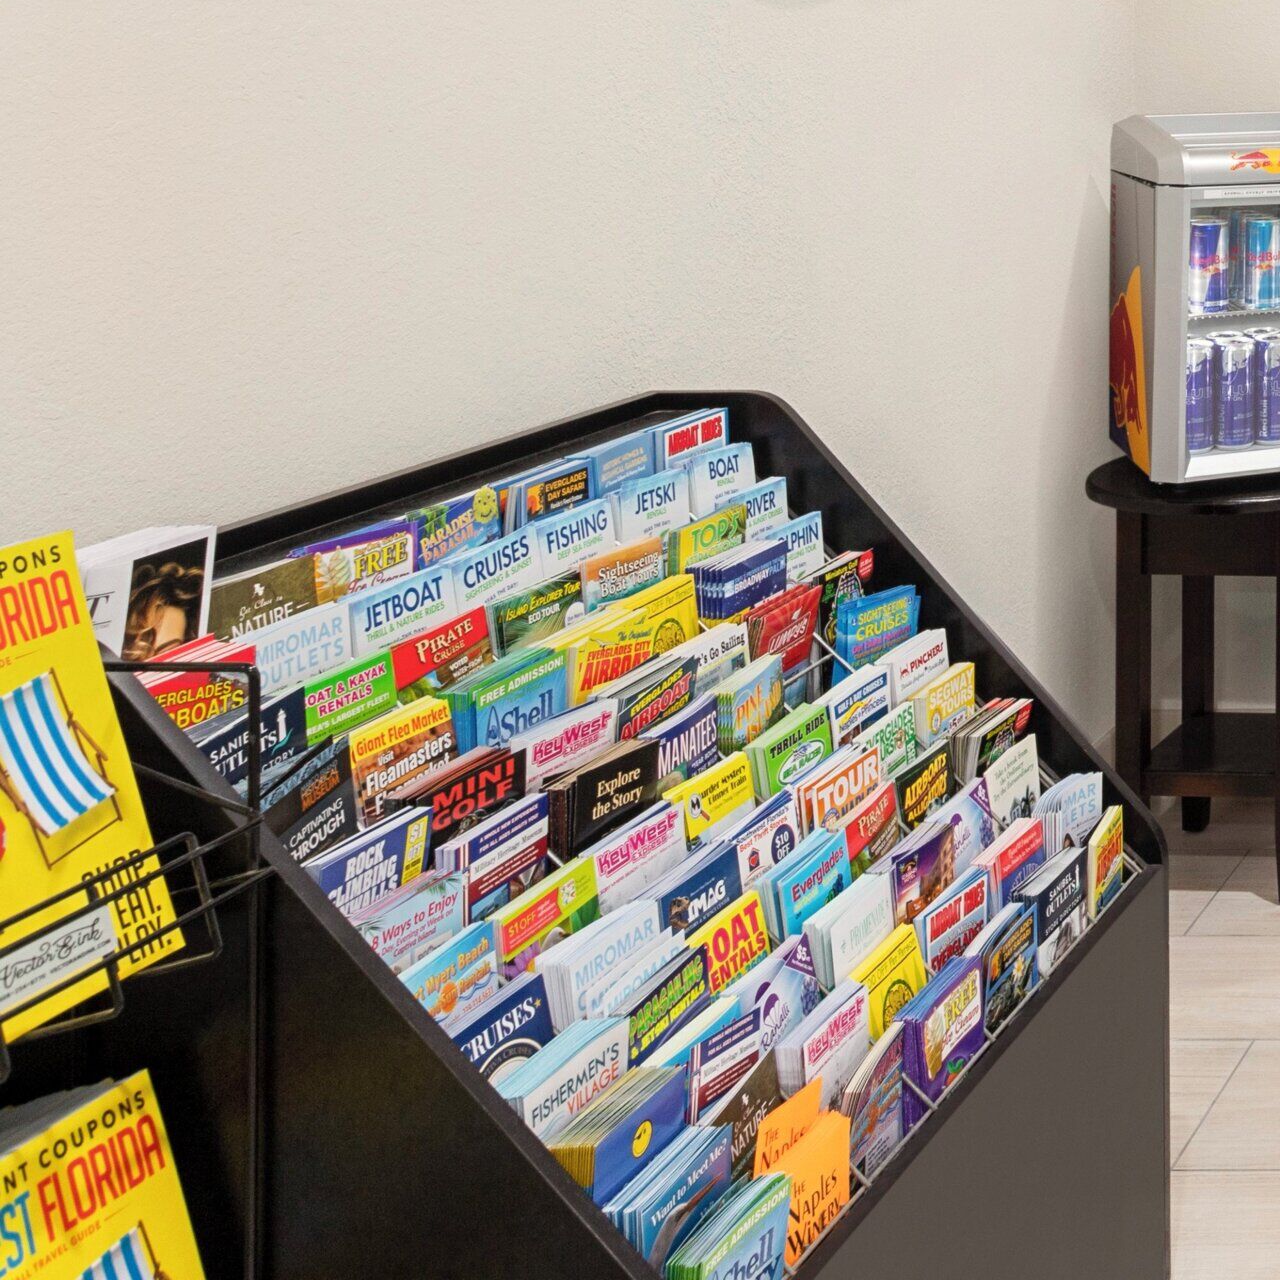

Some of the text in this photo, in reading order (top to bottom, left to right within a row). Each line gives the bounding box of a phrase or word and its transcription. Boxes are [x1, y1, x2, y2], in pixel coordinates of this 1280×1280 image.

[545, 471, 587, 493] EVERGLADES
[709, 454, 739, 480] BOAT
[547, 481, 585, 501] DAY SAFARI
[635, 481, 676, 515] JETSKI
[421, 509, 473, 549] PARADISE
[546, 510, 607, 554] FISHING
[354, 537, 408, 579] FREE
[464, 535, 530, 589] CRUISES
[599, 552, 659, 583] Sightseeing
[506, 582, 581, 621] ISLAND EXPLORER TOUR
[600, 567, 658, 598] Boat Tours
[365, 576, 442, 633] JETBOAT
[425, 602, 445, 617] RIDES
[529, 603, 560, 625] ECO TOUR
[257, 617, 343, 665] MIROMAR
[415, 619, 473, 658] PIRATE
[856, 611, 908, 641] CRUISES
[260, 638, 345, 689] OUTLETS
[434, 639, 465, 664] CRUISE
[587, 641, 650, 661] EVERGLADES CITY
[710, 633, 745, 660] Go Sailing
[910, 642, 944, 673] PINCHERS
[349, 663, 386, 689] KAYAK
[479, 656, 564, 707] FREE ADMISSION!
[929, 670, 973, 706] SEGWAY
[319, 685, 372, 717] RENTALS
[502, 688, 554, 741] Shell
[942, 685, 972, 713] TOURS
[356, 705, 448, 756] Giant Flea Market
[658, 710, 717, 779] MANATEES
[769, 714, 824, 758] THRILL RIDE
[366, 733, 452, 796] Fleamasters
[378, 751, 394, 766] Visit
[905, 752, 947, 805] AIRBOATS
[432, 758, 515, 813] MINI
[597, 768, 640, 798] Explore
[819, 753, 878, 810] TOUR
[289, 798, 343, 847] CAPTIVATING
[592, 784, 643, 821] the Story
[410, 821, 423, 842] $1
[776, 832, 789, 848] $10
[346, 840, 385, 882] ROCK
[777, 845, 790, 859] OFF
[792, 846, 843, 900] Everglades
[1049, 872, 1073, 901] SANIBEL
[688, 879, 727, 923] IMAG
[1046, 880, 1076, 918] OUTLETS
[78, 918, 103, 946] ink
[371, 893, 458, 952] 8 Ways to Enjoy
[520, 912, 537, 932] OFF
[425, 937, 489, 995] Myers Beach
[629, 955, 703, 1046] PARASAILING
[461, 996, 535, 1063] CRUISES
[532, 1041, 619, 1128] FISHERMEN'S
[566, 1061, 619, 1115] VILLAGE
[38, 1090, 145, 1168] COUPONS
[38, 1113, 165, 1243] FLORIDA
[731, 1184, 788, 1247] ADMISSION!
[33, 1220, 101, 1273] TRAVEL GUIDE
